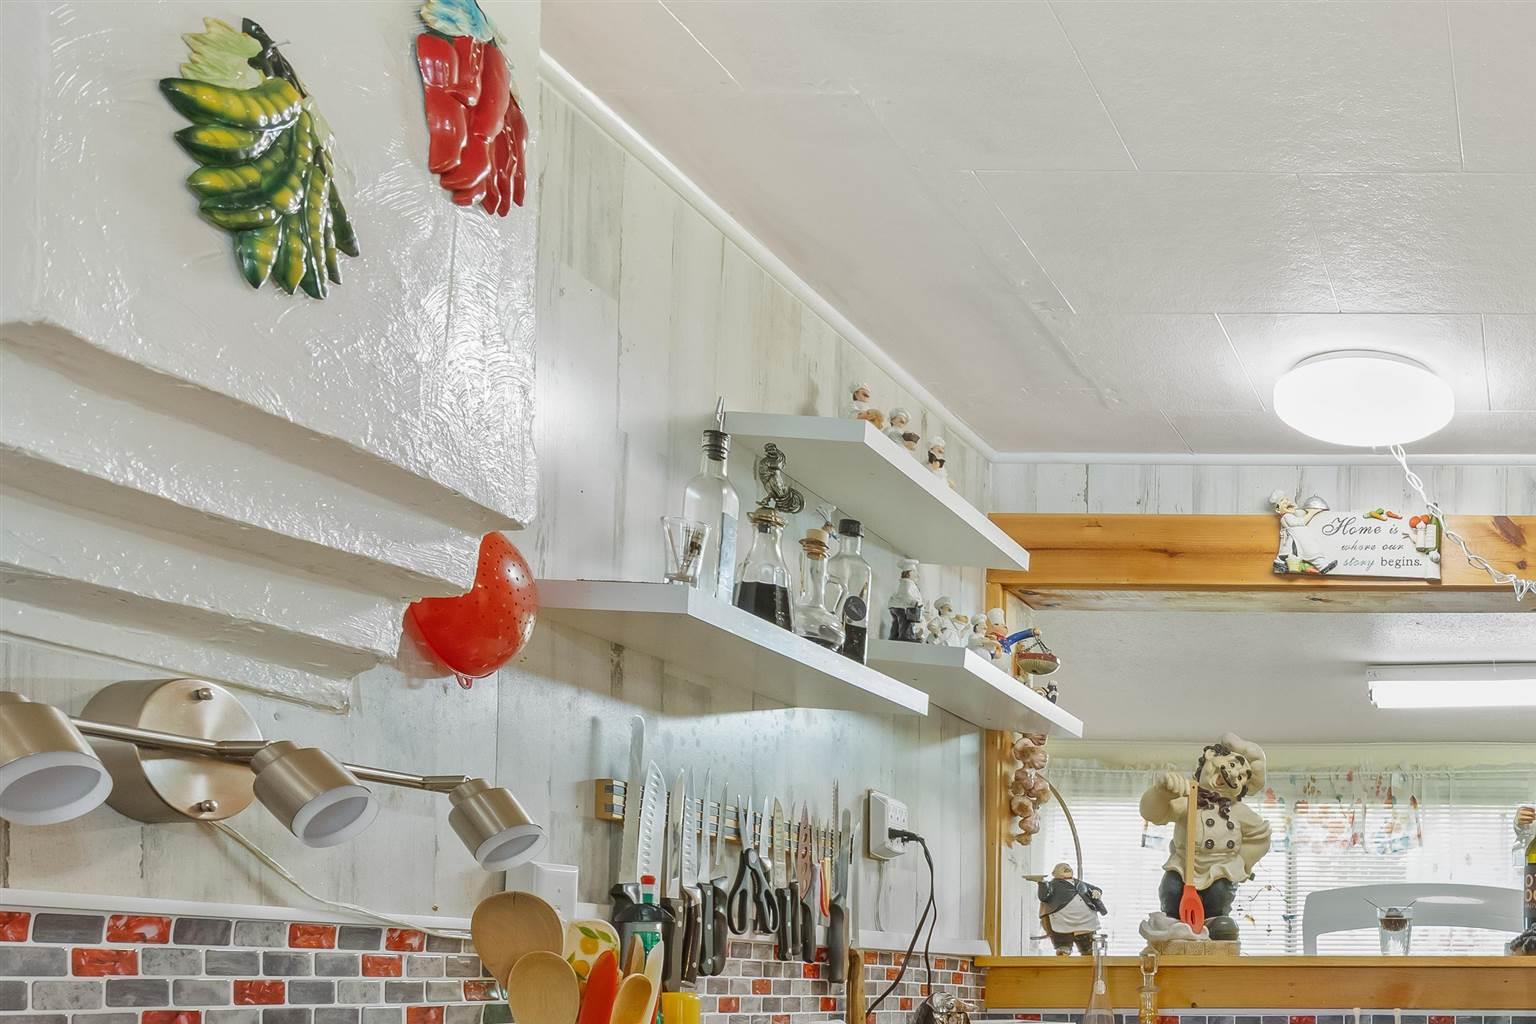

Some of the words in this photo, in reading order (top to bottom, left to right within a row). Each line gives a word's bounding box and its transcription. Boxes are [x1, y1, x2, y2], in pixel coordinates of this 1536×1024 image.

[1321, 516, 1382, 537] Home
[1389, 523, 1399, 535] is
[1382, 543, 1404, 551] our
[1380, 556, 1422, 569] begins.
